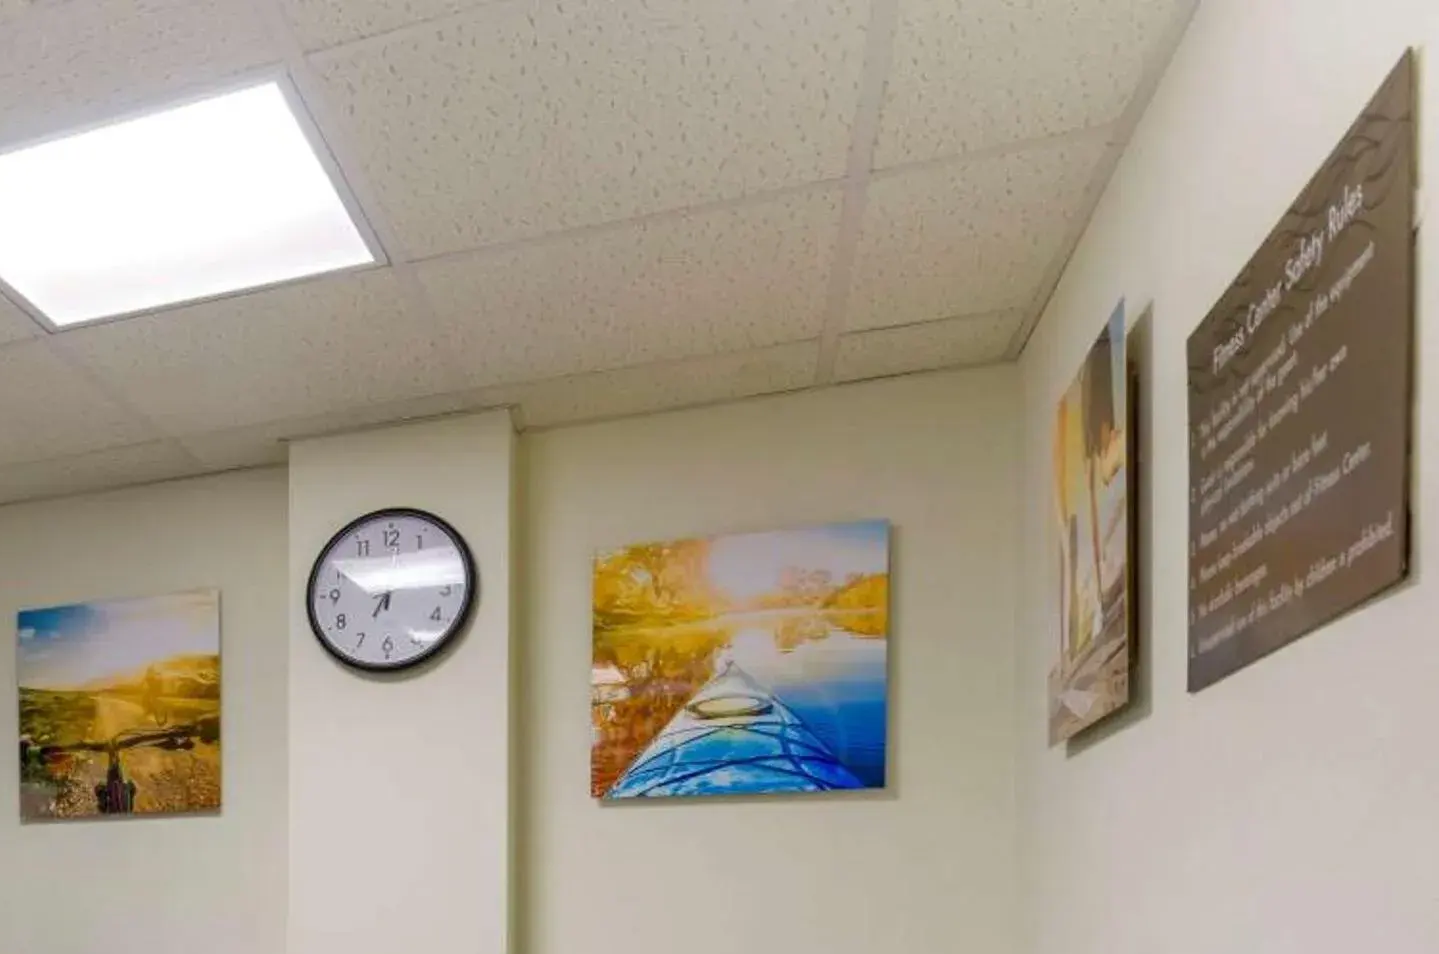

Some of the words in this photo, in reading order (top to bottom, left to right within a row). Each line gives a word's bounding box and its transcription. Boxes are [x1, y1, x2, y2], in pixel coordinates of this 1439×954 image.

[1212, 326, 1244, 373] Fitness
[1246, 280, 1282, 334] Center
[1284, 231, 1323, 289] Safety
[1328, 183, 1363, 239] Rules
[382, 530, 400, 547] 12
[416, 534, 423, 550] 1
[356, 540, 370, 557] 11
[329, 588, 341, 606] 9
[336, 613, 347, 630] 8
[429, 606, 441, 621] 4
[356, 633, 366, 649] 7
[382, 635, 393, 652] 6
